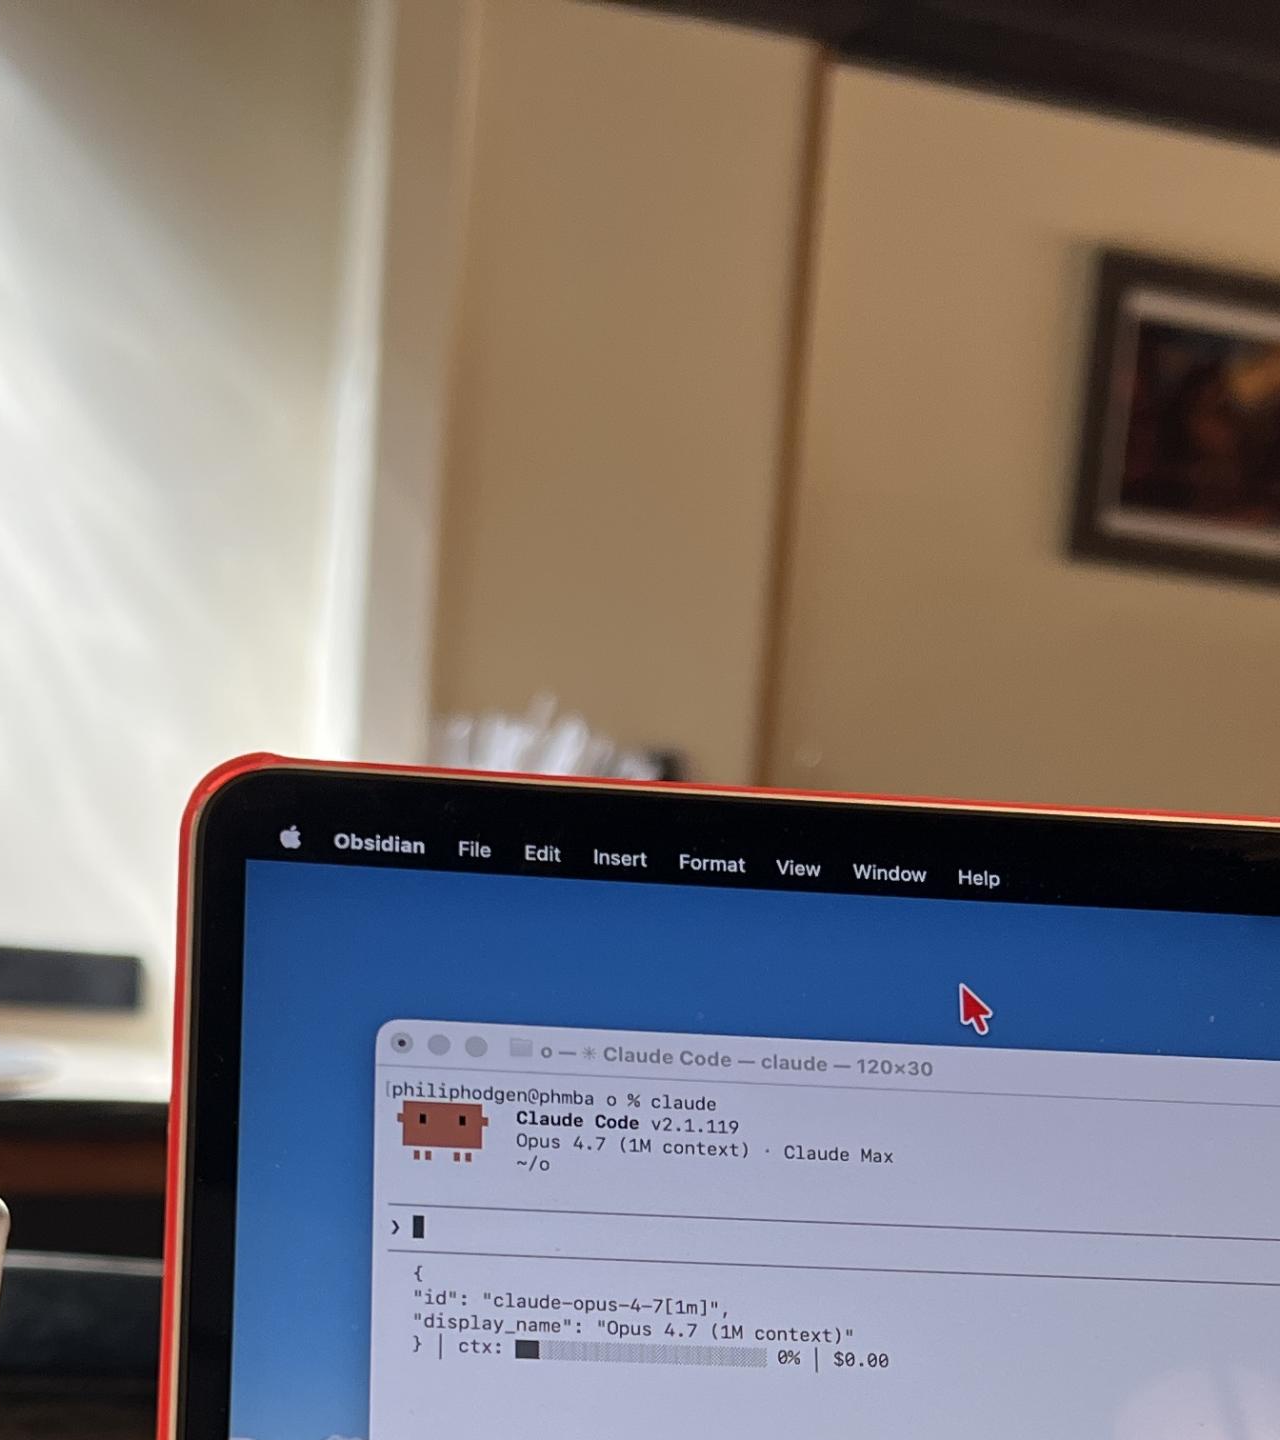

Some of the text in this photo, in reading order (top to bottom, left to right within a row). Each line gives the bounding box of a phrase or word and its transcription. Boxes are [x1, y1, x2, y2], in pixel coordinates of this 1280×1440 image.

[333, 832, 426, 855] Obsidian
[457, 839, 492, 860] File
[523, 843, 562, 863] Edit
[592, 848, 648, 868] Insert
[678, 852, 747, 874] Format
[775, 858, 822, 878] View
[852, 863, 928, 883] Window
[957, 868, 1001, 890] Help
[602, 1045, 674, 1066] Claude
[679, 1049, 733, 1069] Code
[760, 1053, 828, 1073] claude
[626, 1093, 641, 1108] %
[651, 1093, 717, 1112] claude
[516, 1110, 739, 1136] Claude Code v2.1.119
[516, 1133, 894, 1165] Opus 4.7 (1M context) Claude Max
[516, 1154, 550, 1173] ~/o
[414, 1289, 468, 1307] "id":
[597, 1319, 652, 1339] "Opus
[663, 1323, 698, 1339] 4.7
[711, 1323, 744, 1342] (1M
[755, 1327, 853, 1345] context)"
[458, 1339, 502, 1354] ctx:
[777, 1349, 801, 1366] 0%
[833, 1351, 889, 1368] $0.00
